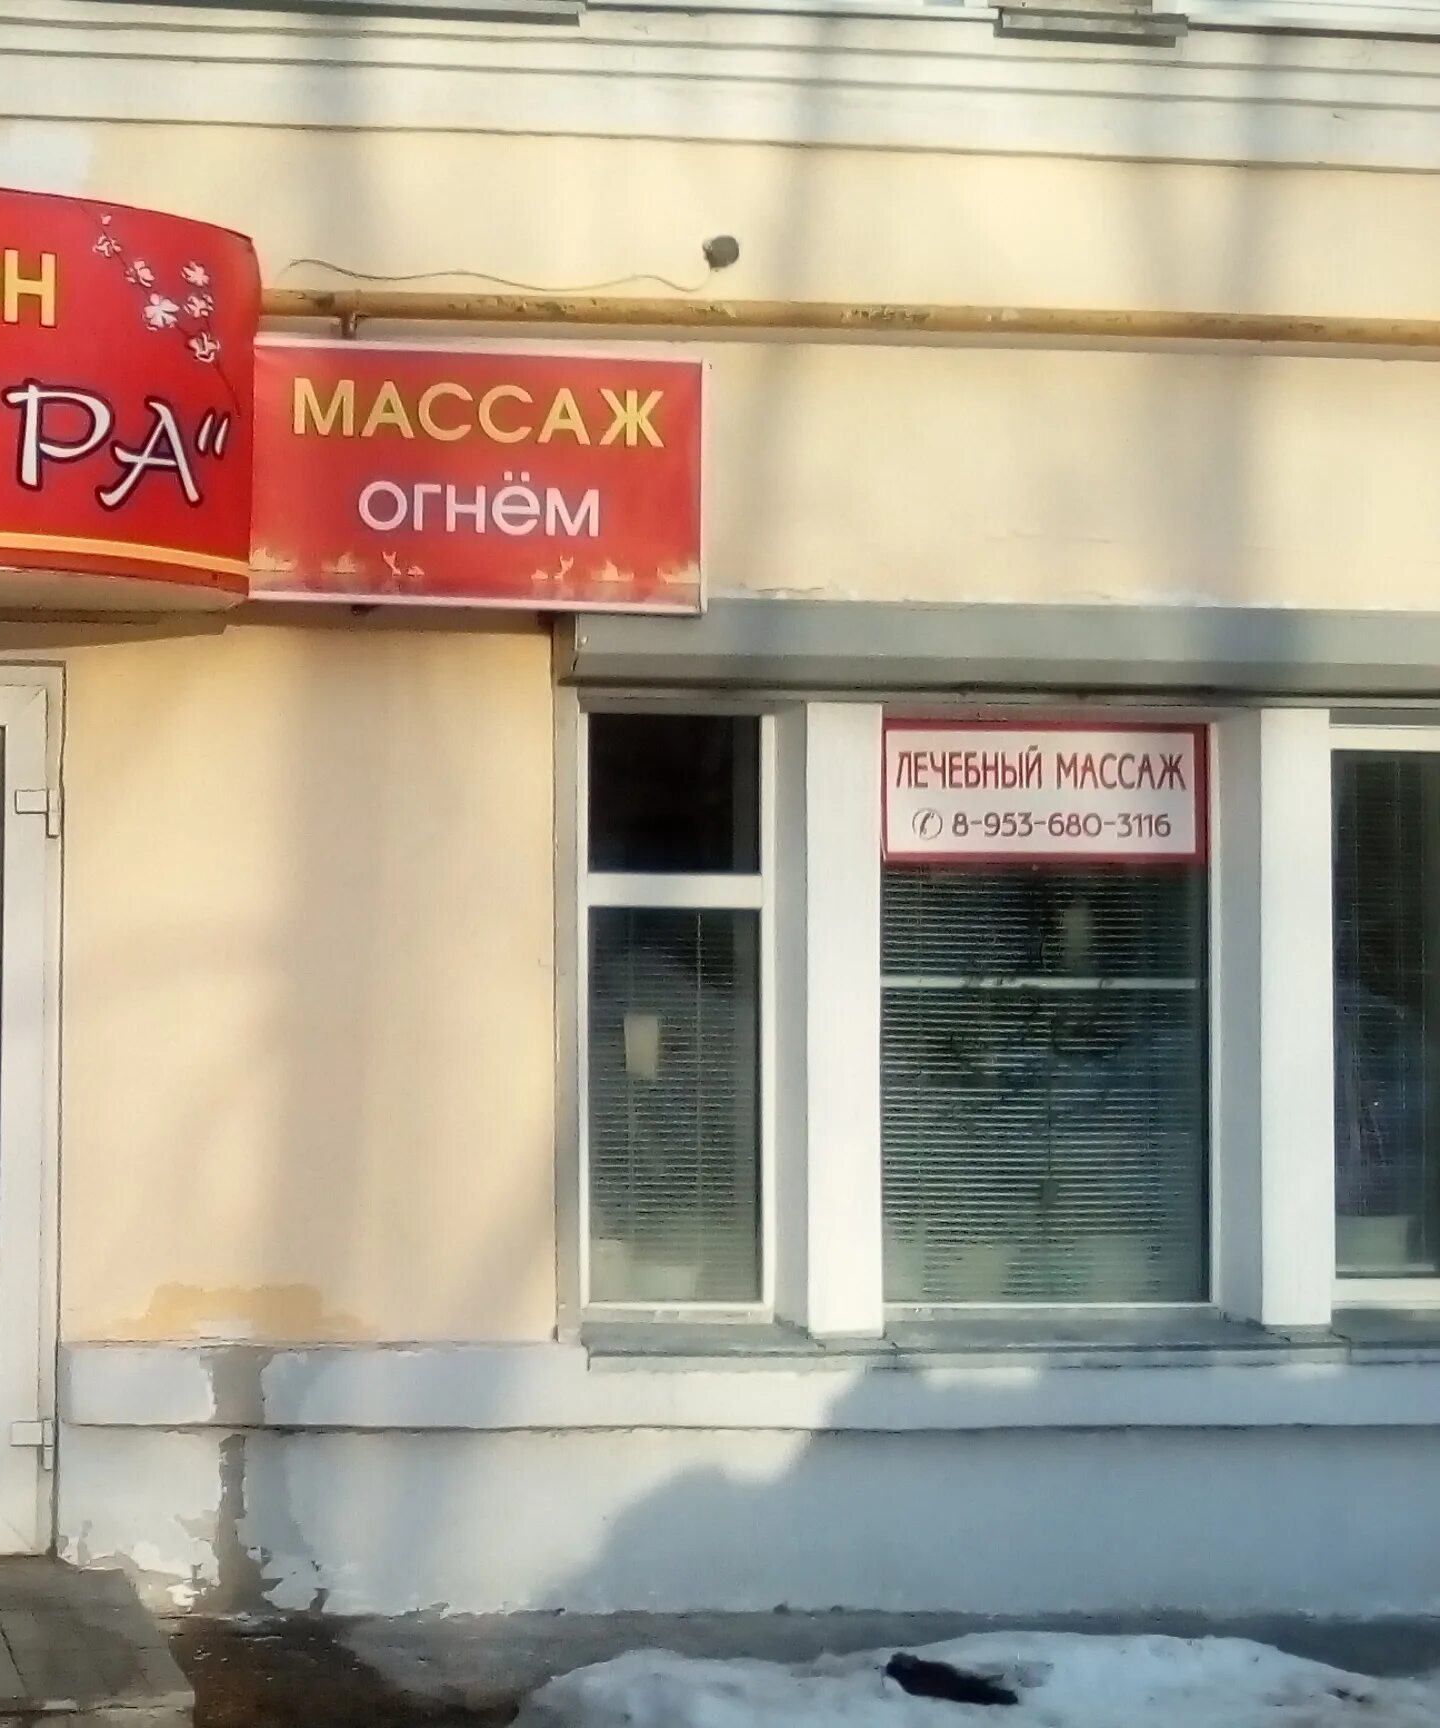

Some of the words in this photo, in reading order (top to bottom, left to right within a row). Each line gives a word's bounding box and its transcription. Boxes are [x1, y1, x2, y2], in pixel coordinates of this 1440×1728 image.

[292, 376, 666, 448] МАССАЖ
[895, 744, 1043, 790] ЛЕЧЕБНЫЙ
[1055, 752, 1188, 791] МАССАЖ
[951, 811, 1172, 838] 8-953-680-3116
